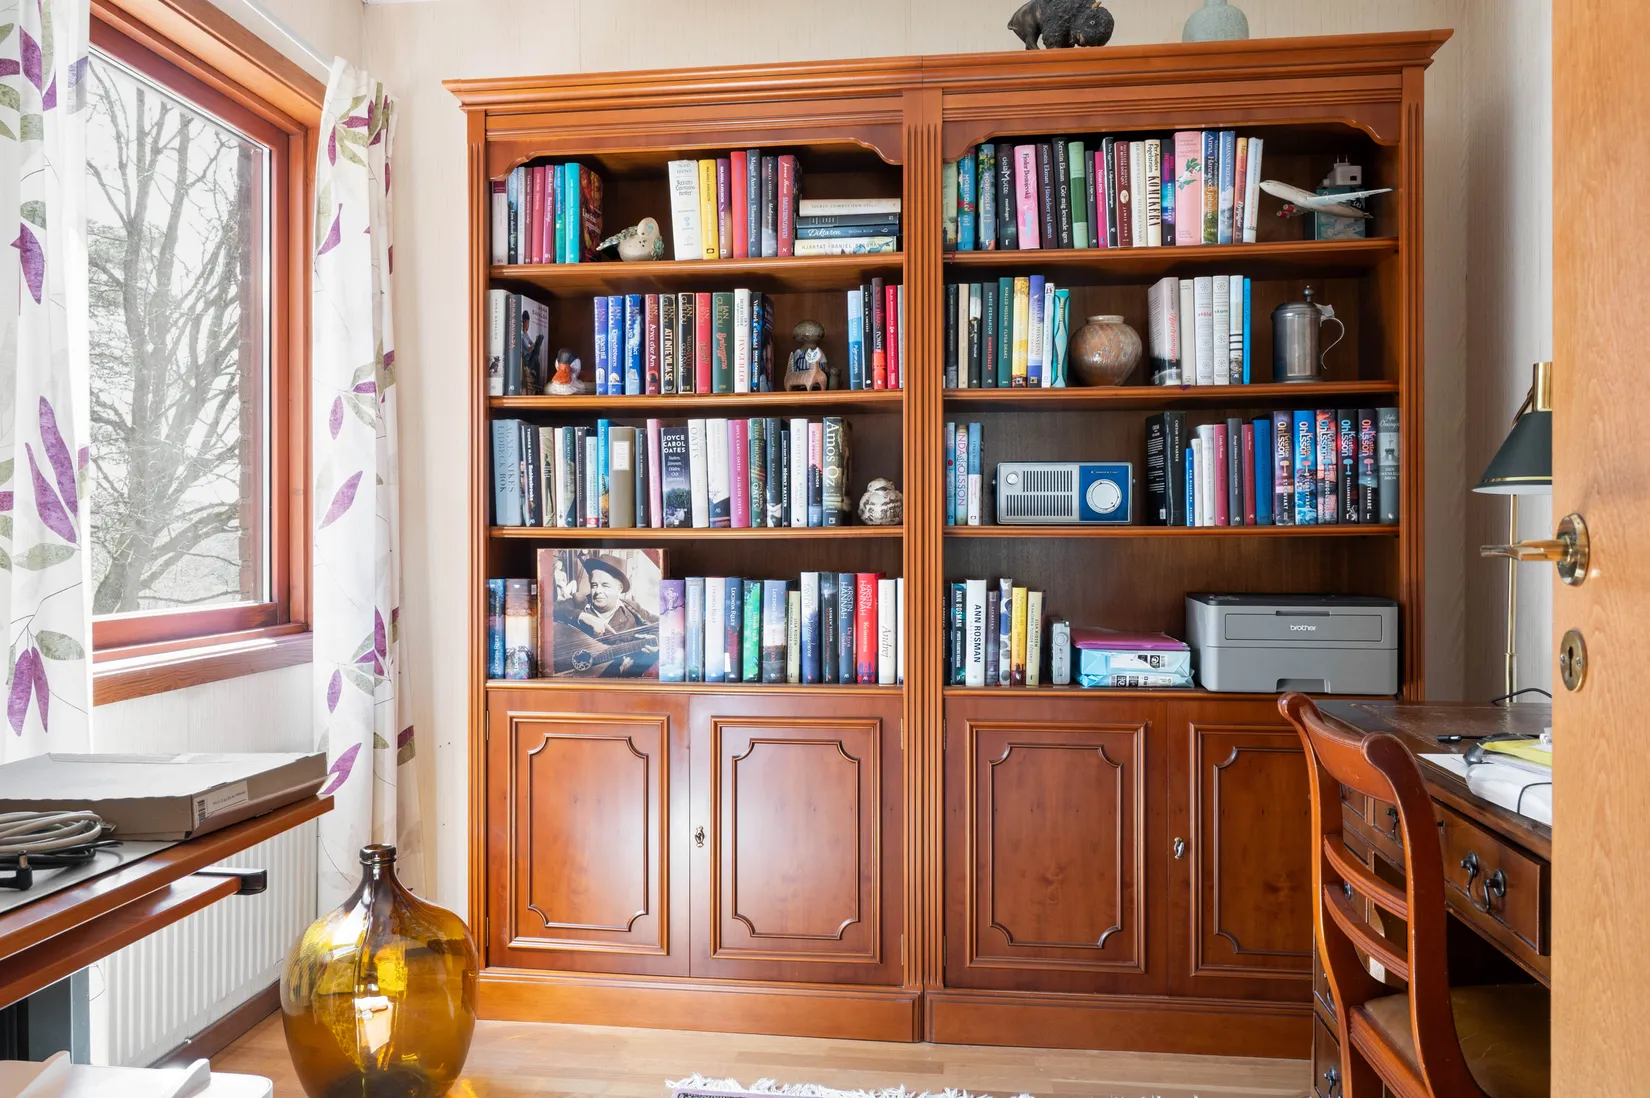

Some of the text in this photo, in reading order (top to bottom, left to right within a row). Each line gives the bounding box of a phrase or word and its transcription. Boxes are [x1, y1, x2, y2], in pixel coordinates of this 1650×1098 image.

[1206, 191, 1214, 219] Johanna
[808, 228, 842, 237] Diktaren
[721, 305, 729, 319] JAN
[664, 328, 672, 340] ATT
[717, 332, 728, 369] Brobyggarna
[665, 355, 673, 372] VILJA
[665, 373, 673, 381] SE
[497, 425, 505, 468] LIDBECK
[506, 426, 514, 458] AGNES
[690, 427, 699, 459] OATES
[826, 421, 839, 487] Amos Oz
[1278, 421, 1291, 458] Ohlsson
[1299, 421, 1312, 458] Ohlsson
[1319, 420, 1333, 456] Ohlsson
[1341, 420, 1355, 456] Ohlsson
[1348, 431, 1356, 456] Kristina
[1362, 419, 1376, 456] Ohlsson
[957, 465, 966, 506] OLSSON
[840, 581, 848, 619] HANNAH
[859, 580, 867, 616] HANNAH
[862, 622, 870, 652] Kvinnorna
[880, 626, 892, 658] Andrej
[973, 604, 982, 663] ANN ROSMAN
[1290, 624, 1317, 632] brother
